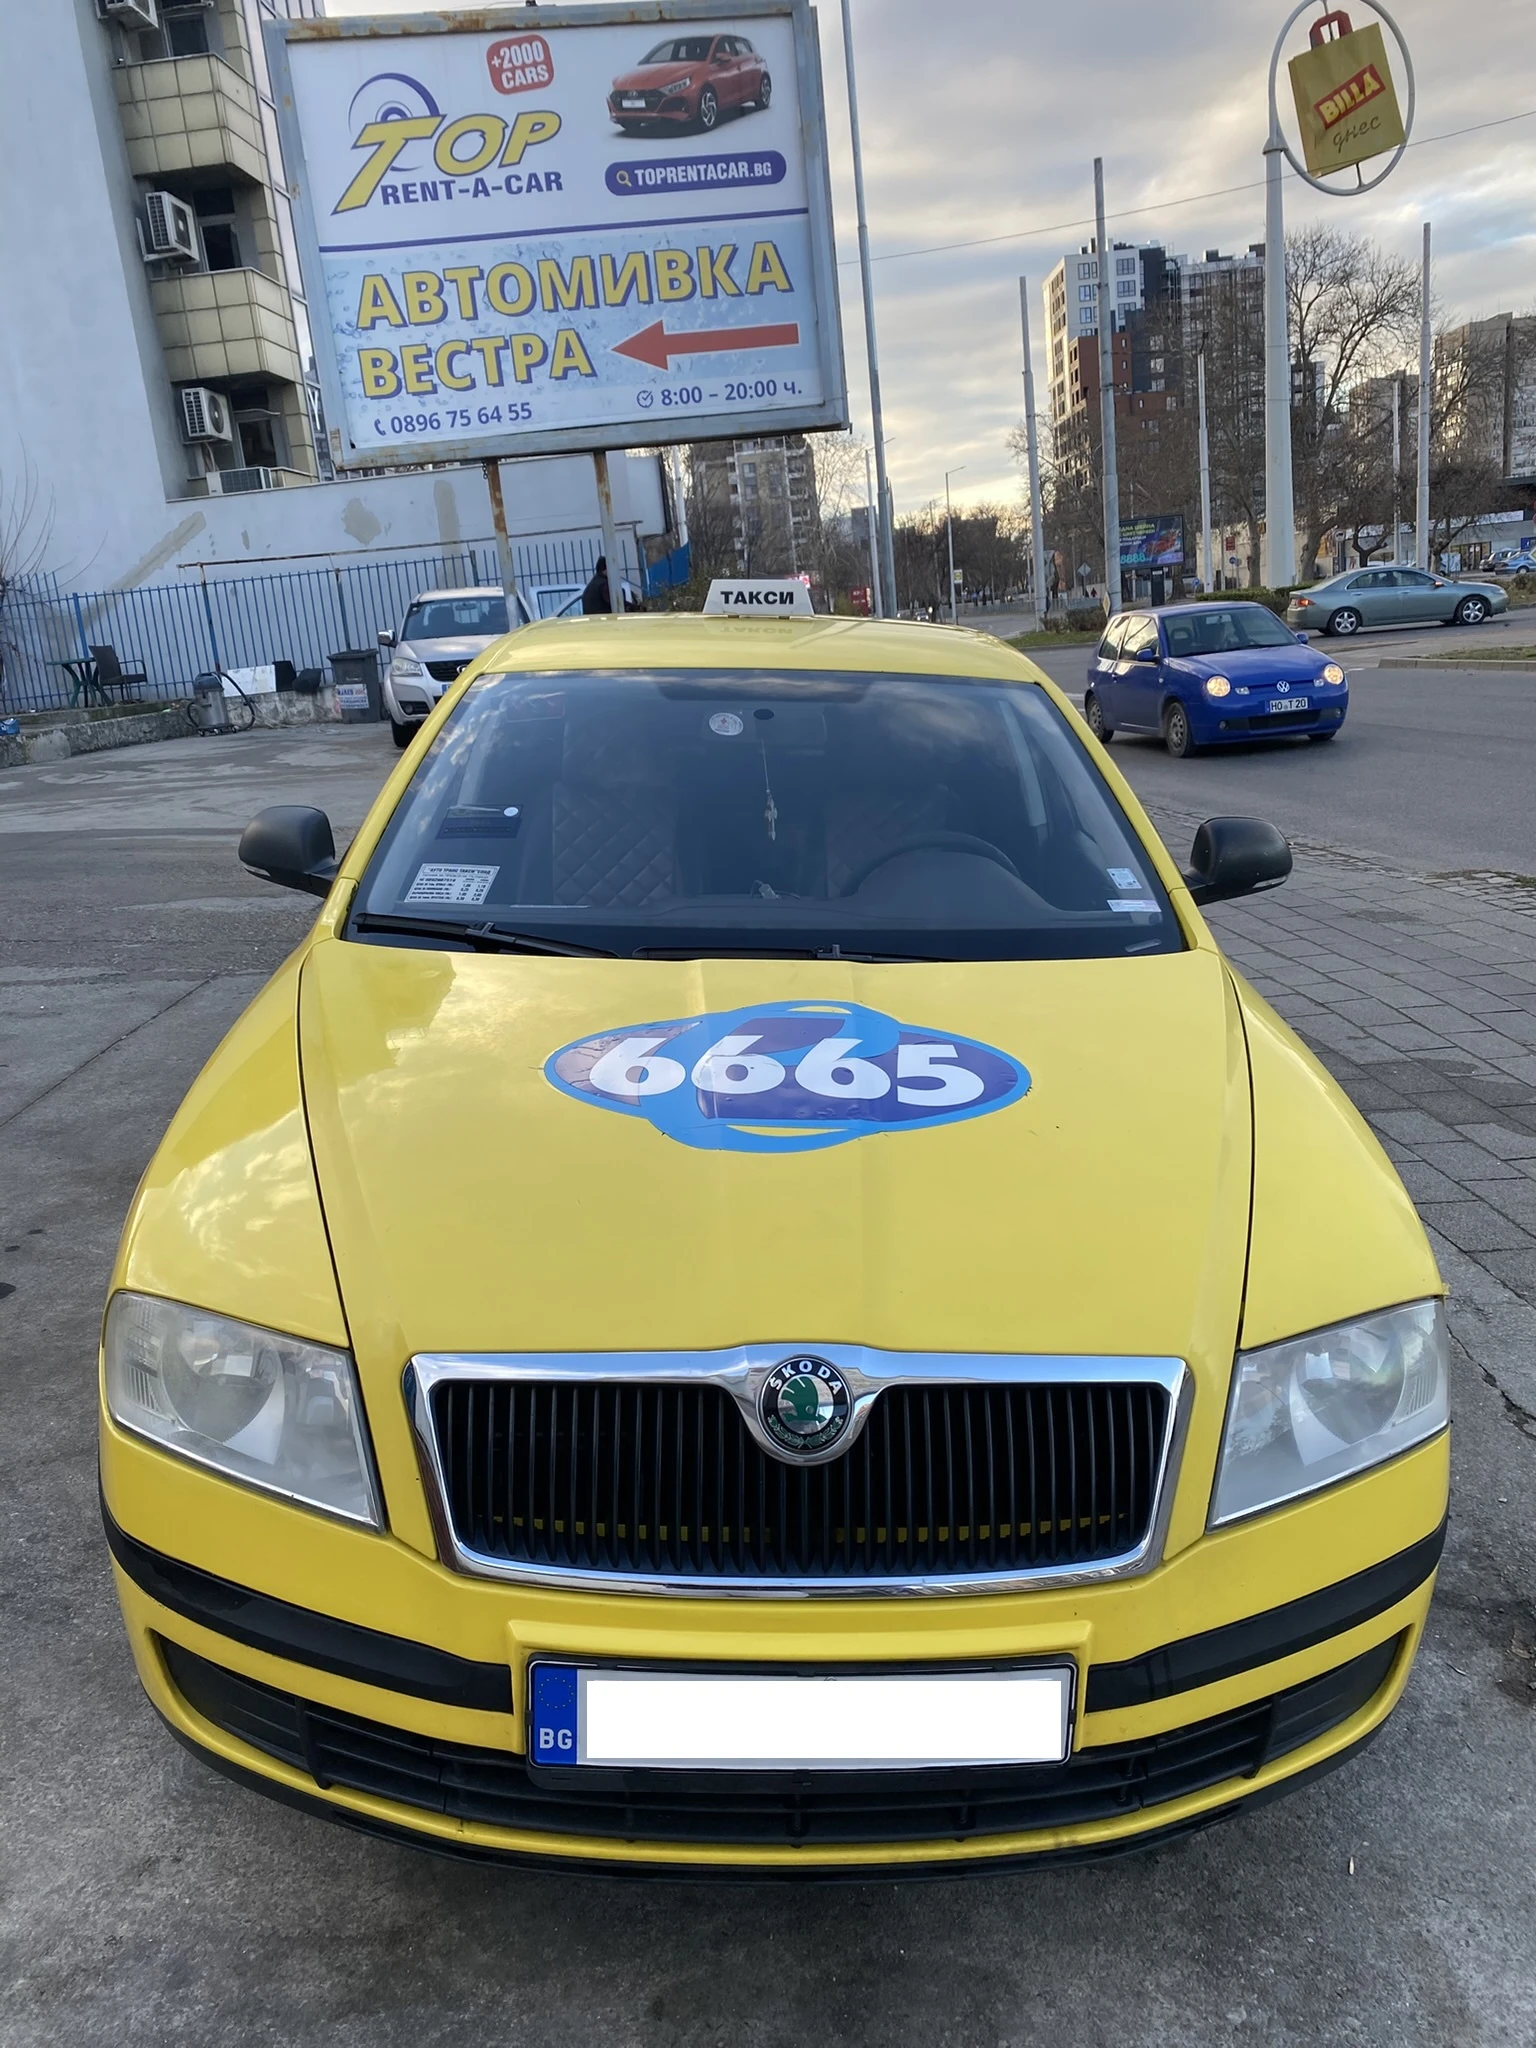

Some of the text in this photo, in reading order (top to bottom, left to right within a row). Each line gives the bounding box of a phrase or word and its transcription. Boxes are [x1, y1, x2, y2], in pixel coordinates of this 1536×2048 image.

[491, 41, 544, 69] +2000
[501, 64, 549, 89] CARS
[1319, 71, 1380, 124] BILLA
[330, 110, 562, 216] TOP
[634, 161, 773, 186] TOPRENTACAR.BG
[380, 171, 563, 205] RENT-A-CAR
[357, 240, 794, 331] АВТОМИВКА
[357, 328, 598, 400] ВЕСТРА
[661, 386, 703, 406] 8:00
[724, 379, 778, 401] 20:00
[783, 381, 802, 395] ч.
[390, 402, 532, 434] 0896 75 64 55
[720, 591, 794, 605] ТАКСИ
[1295, 698, 1307, 708] 20
[588, 1035, 985, 1107] 6665
[539, 1727, 573, 1750] BG
